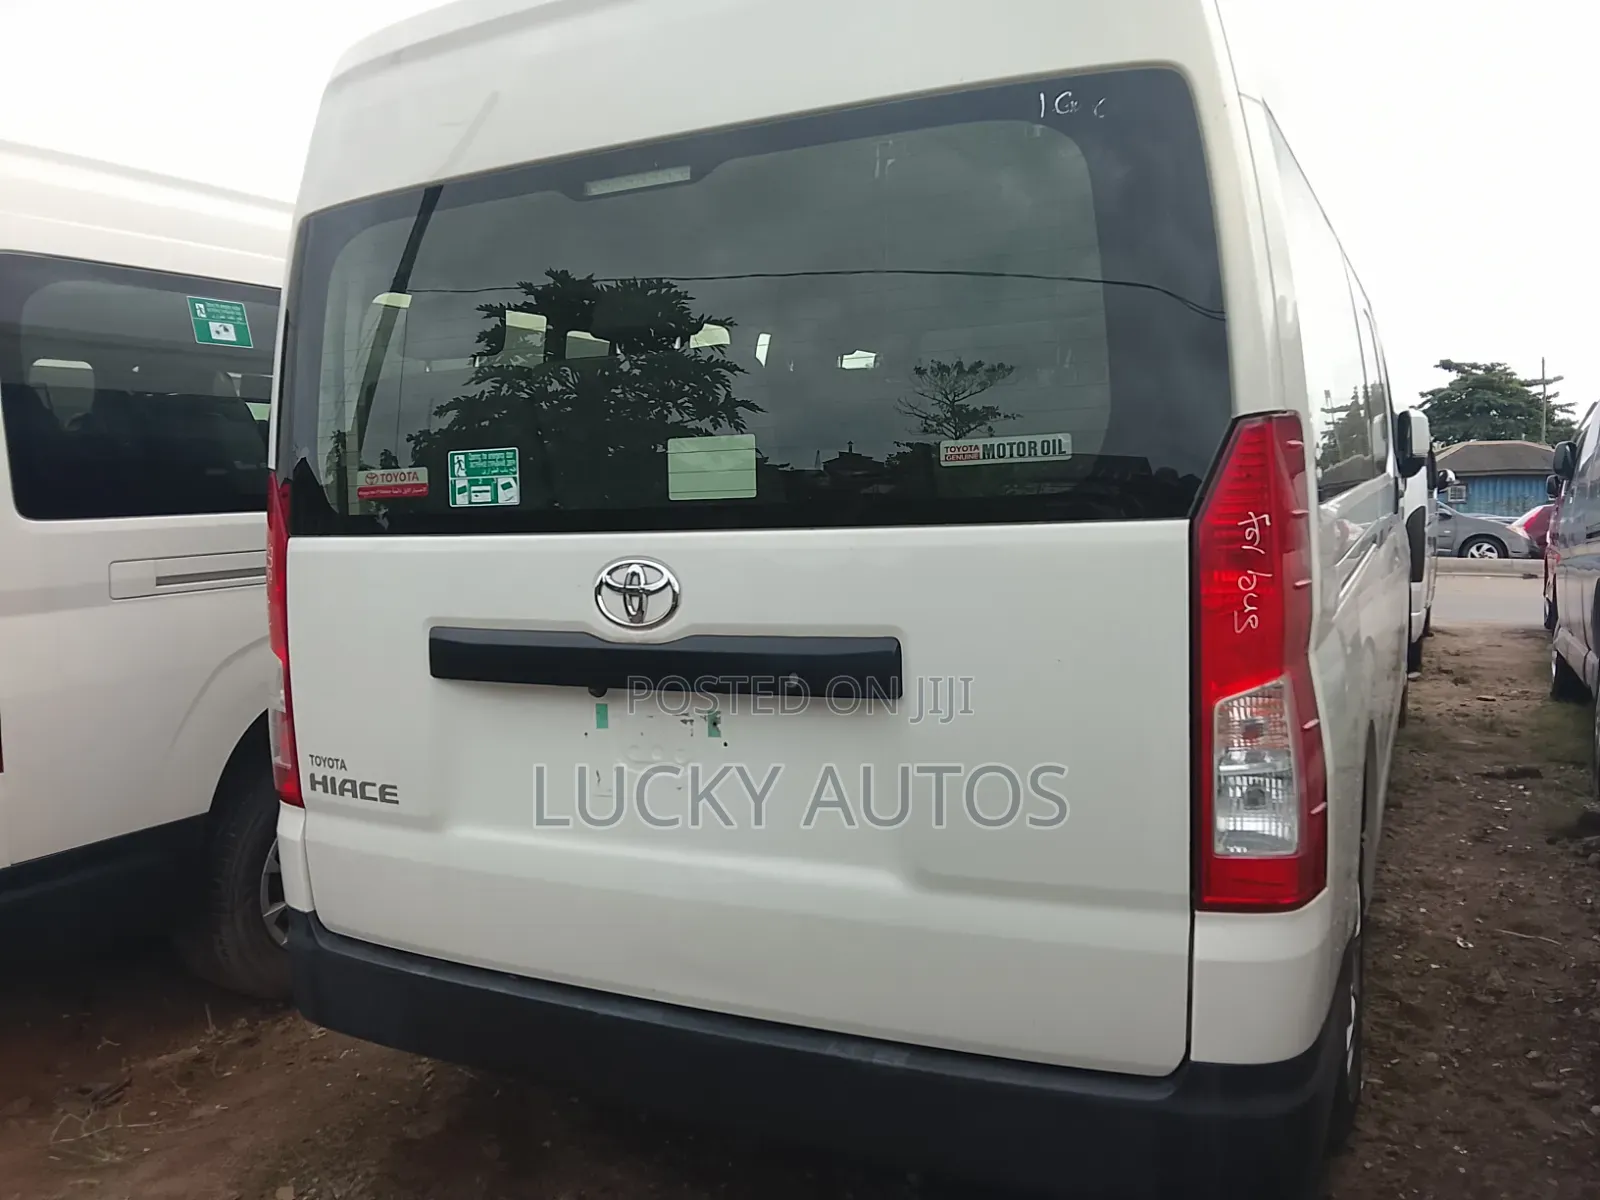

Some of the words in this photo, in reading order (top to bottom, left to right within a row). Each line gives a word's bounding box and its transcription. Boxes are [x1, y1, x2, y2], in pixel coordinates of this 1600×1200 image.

[943, 444, 980, 454] TOYOTA
[981, 440, 1038, 460] MOTOR
[1040, 438, 1067, 456] OIL
[944, 453, 980, 462] GENUINE
[379, 471, 420, 484] TOYOTA
[308, 753, 348, 772] TOYOTA
[308, 772, 400, 805] HIACE
